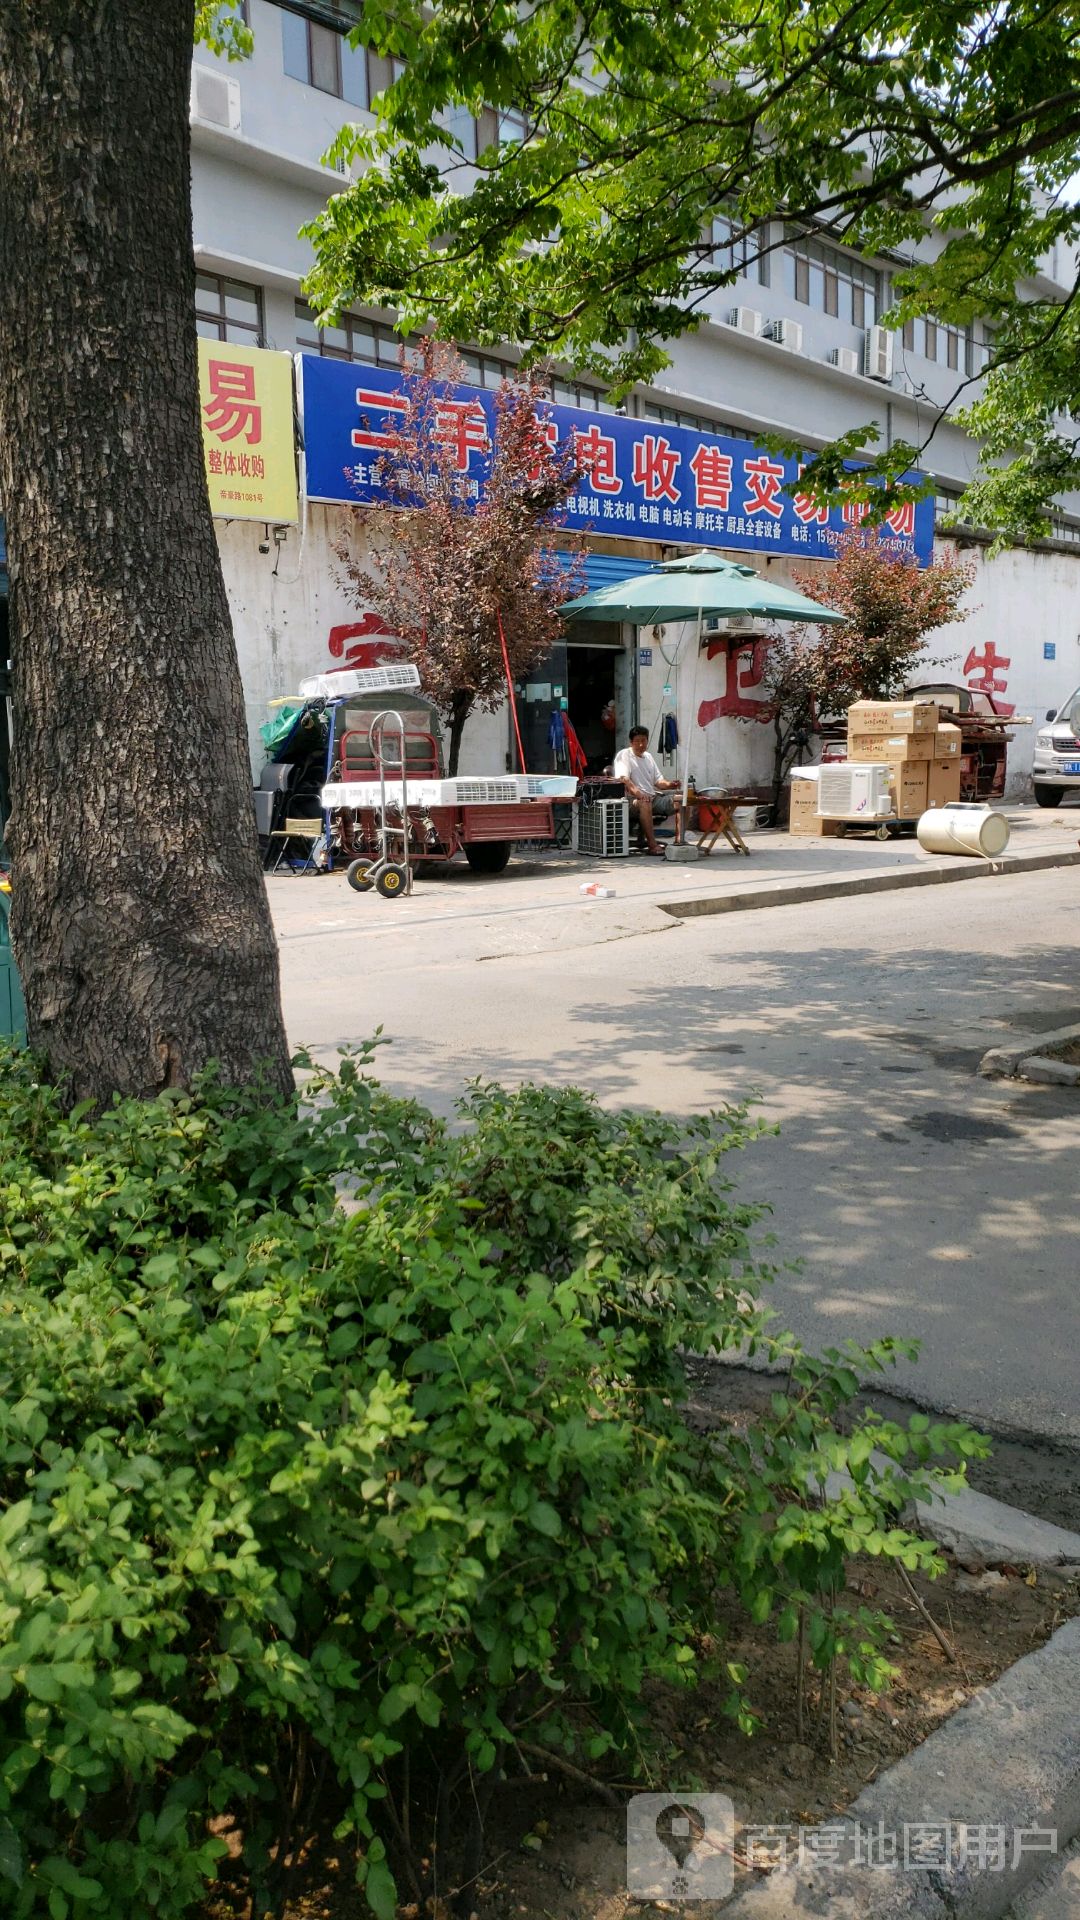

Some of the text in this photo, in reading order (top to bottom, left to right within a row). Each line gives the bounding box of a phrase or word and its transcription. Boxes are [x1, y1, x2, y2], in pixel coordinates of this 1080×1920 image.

[203, 359, 262, 445] 易
[208, 448, 265, 480] 整体收购
[351, 387, 916, 536] 二手电收售交易
[566, 496, 600, 517] 电视机
[603, 499, 636, 521] 洗衣机
[639, 504, 660, 524] 电脑
[663, 507, 693, 529] 电动车
[695, 511, 724, 533] 摩托车
[726, 516, 781, 540] 厨具全套设备
[963, 641, 1017, 719] 生
